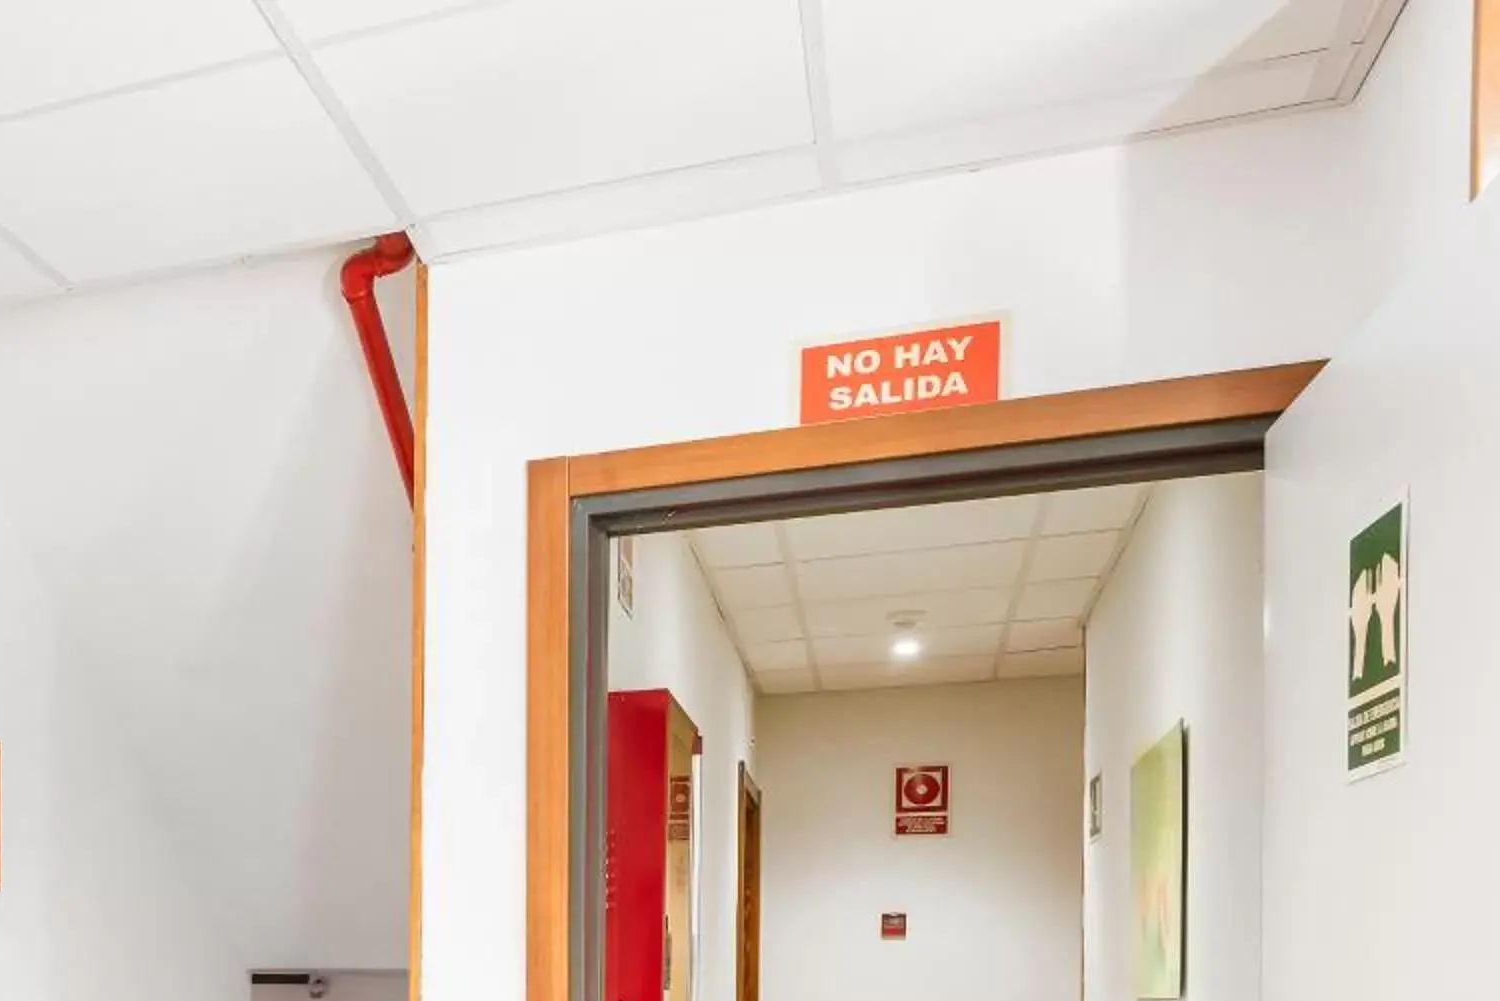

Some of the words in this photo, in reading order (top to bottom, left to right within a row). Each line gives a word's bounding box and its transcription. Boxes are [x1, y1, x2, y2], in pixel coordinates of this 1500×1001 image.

[827, 349, 881, 379] NO
[894, 336, 973, 369] HAY
[829, 371, 969, 411] SALIDA
